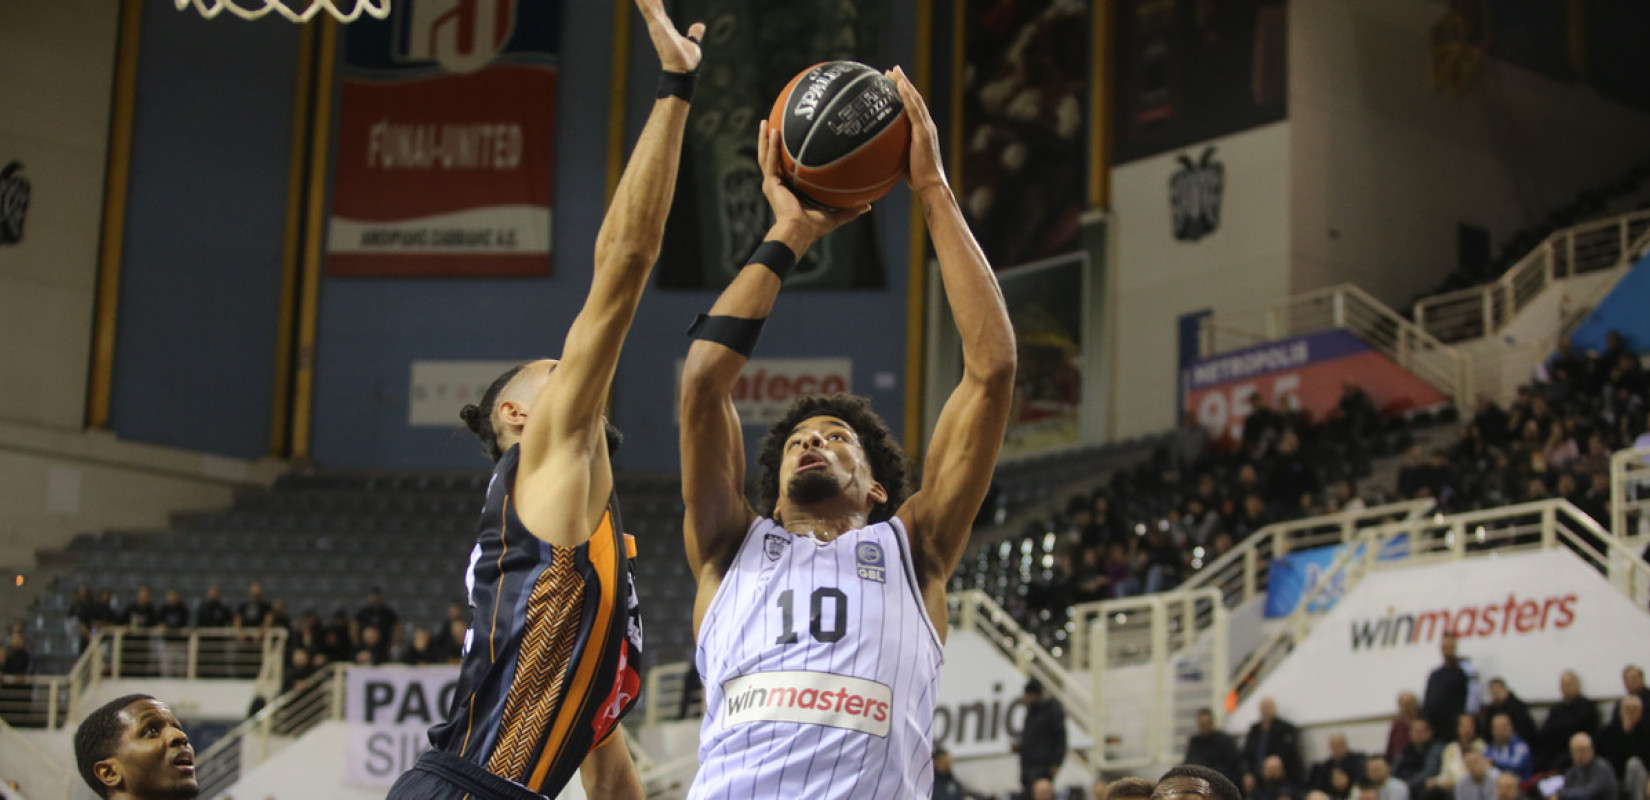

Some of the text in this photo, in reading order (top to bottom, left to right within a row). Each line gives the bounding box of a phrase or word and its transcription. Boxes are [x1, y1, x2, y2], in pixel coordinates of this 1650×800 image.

[1193, 340, 1308, 384] METROPOLIS
[858, 568, 885, 583] GBL
[775, 586, 848, 645] 10
[1350, 592, 1578, 650] winmasters
[727, 685, 889, 722] winmasters
